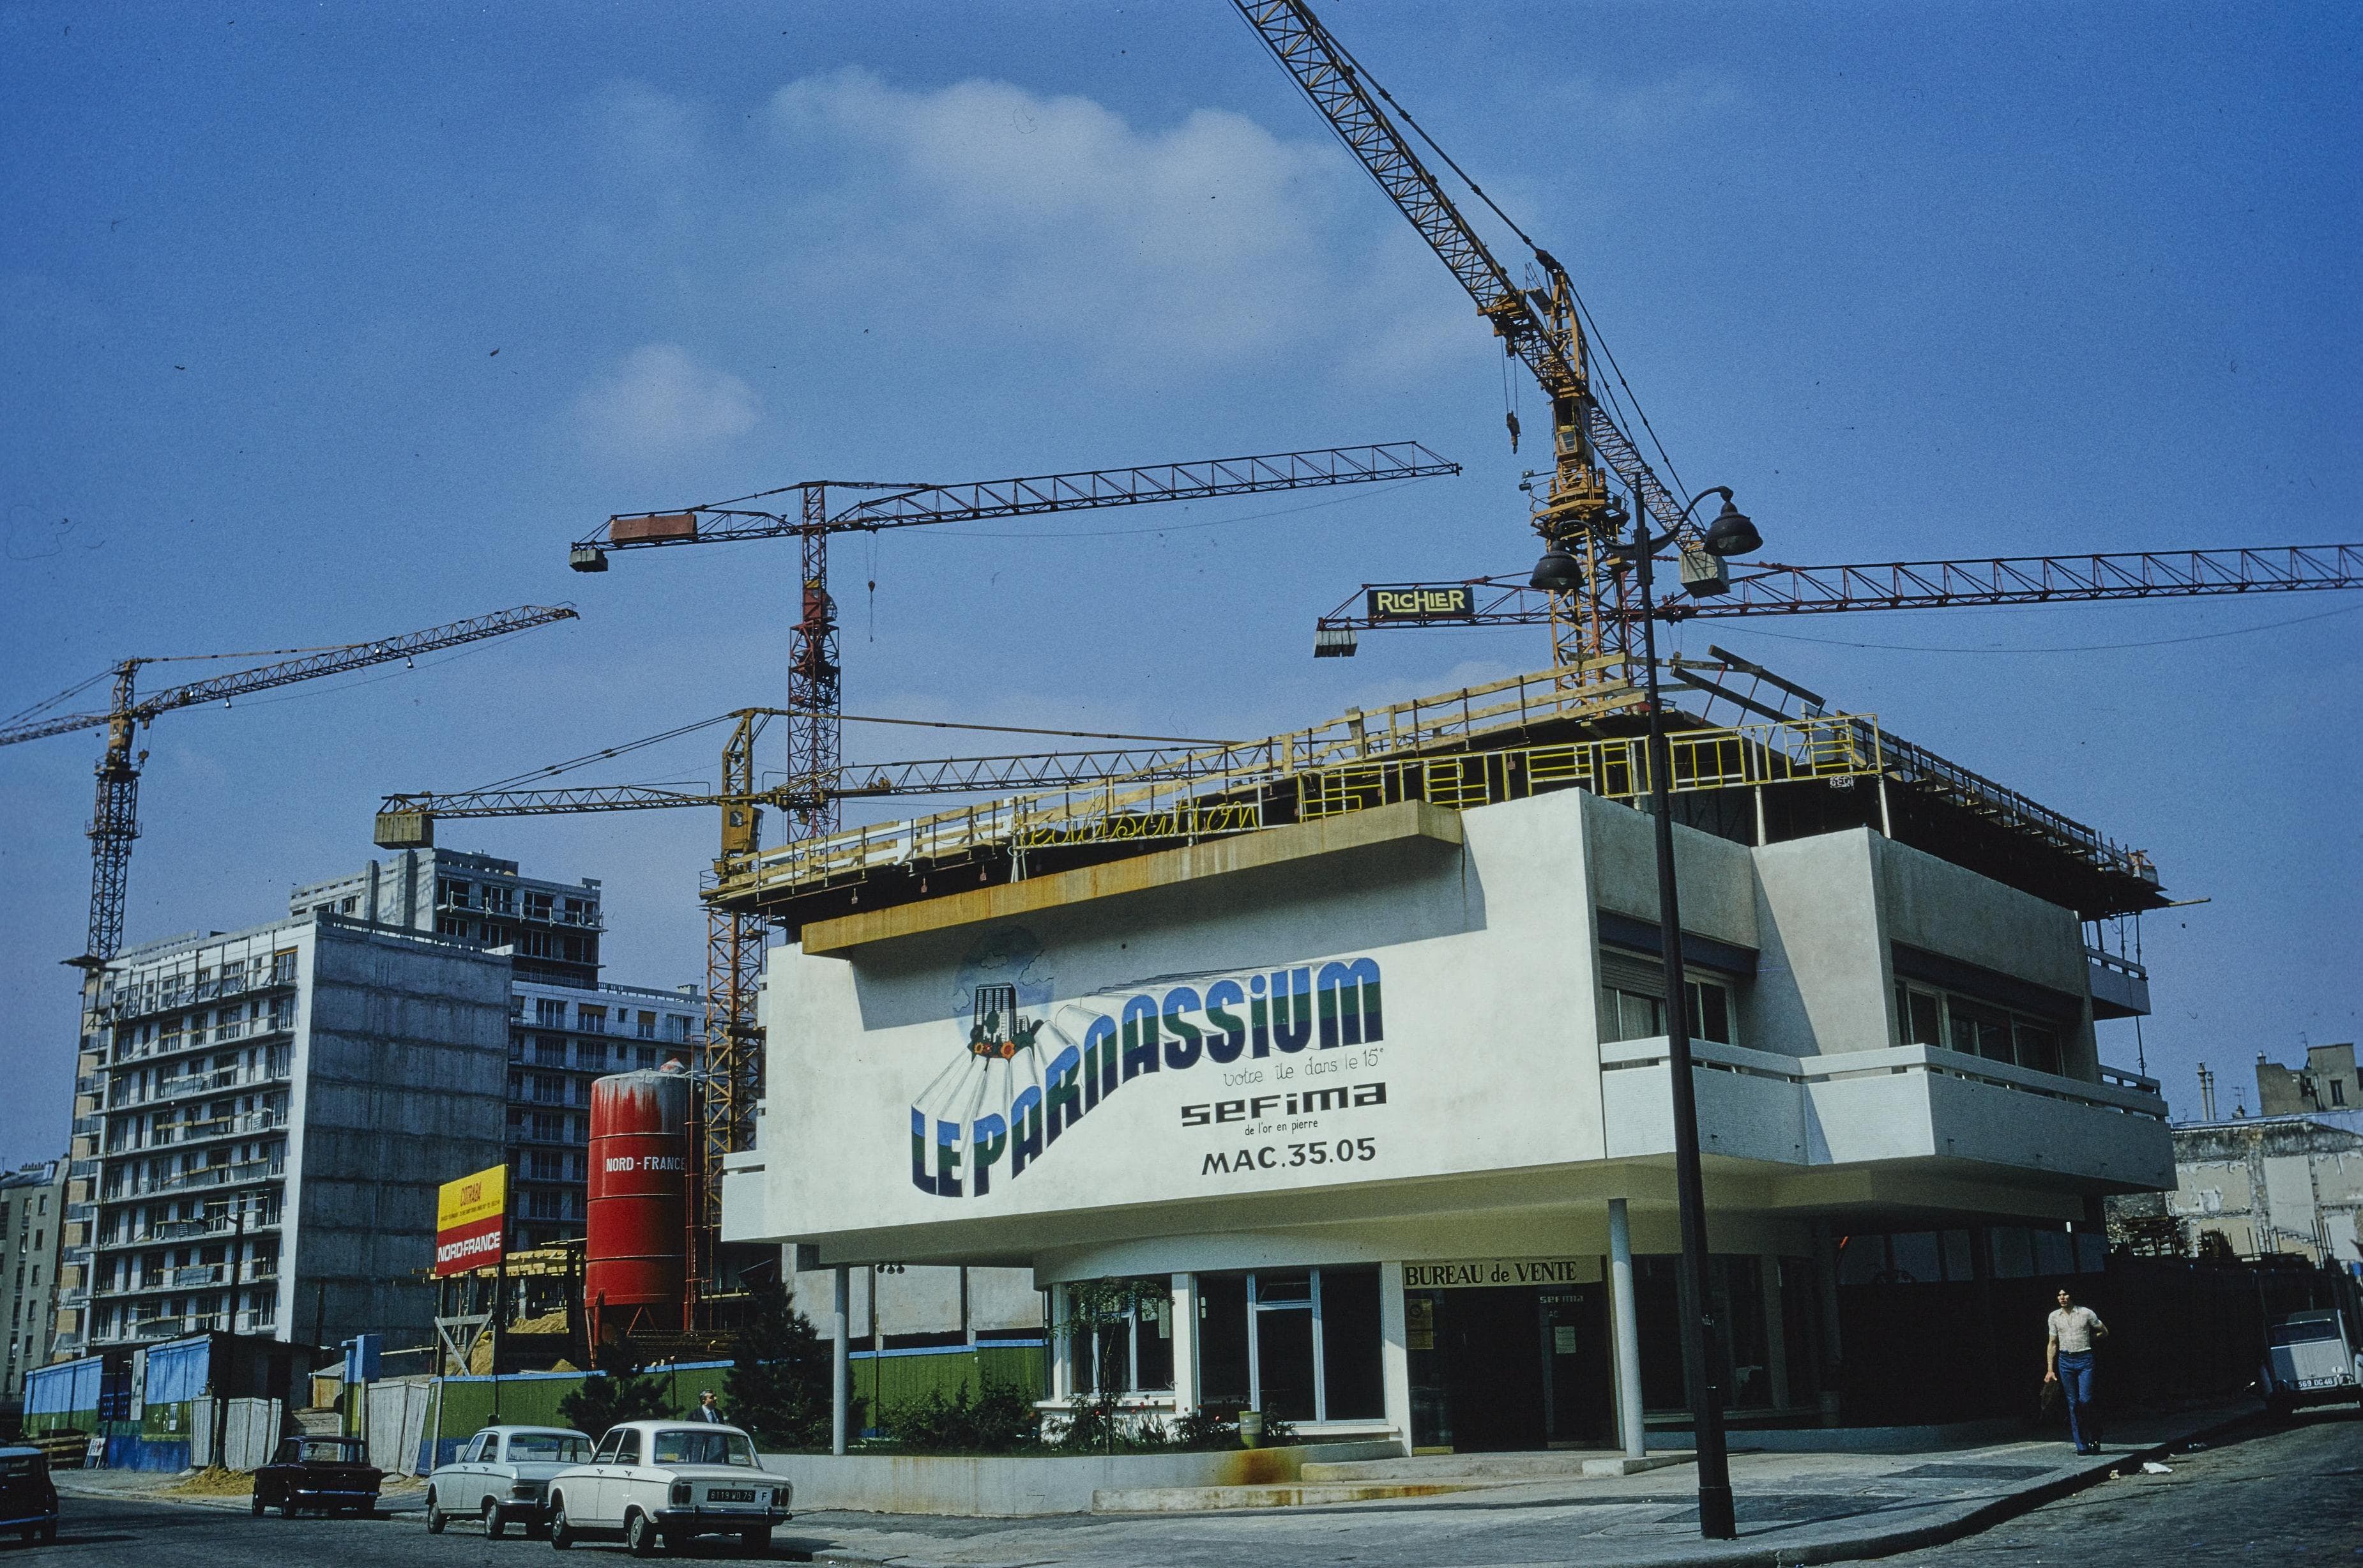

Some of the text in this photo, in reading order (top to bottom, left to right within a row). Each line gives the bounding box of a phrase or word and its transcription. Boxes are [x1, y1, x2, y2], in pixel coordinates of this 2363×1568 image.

[1377, 590, 1465, 614] RICHIER
[1224, 1068, 1263, 1086] votre
[1275, 1063, 1294, 1079] île
[1305, 1056, 1338, 1076] dans
[1344, 1053, 1358, 1070] le
[1245, 1120, 1318, 1136] de l'or en pierre
[911, 1106, 962, 1198] LE
[1201, 1137, 1376, 1175] MAC.35.05
[606, 1157, 634, 1173] NORD
[644, 1156, 686, 1171] FRANCE
[1404, 1261, 1577, 1286] BUREAU de VENTE
[761, 1492, 767, 1501] F
